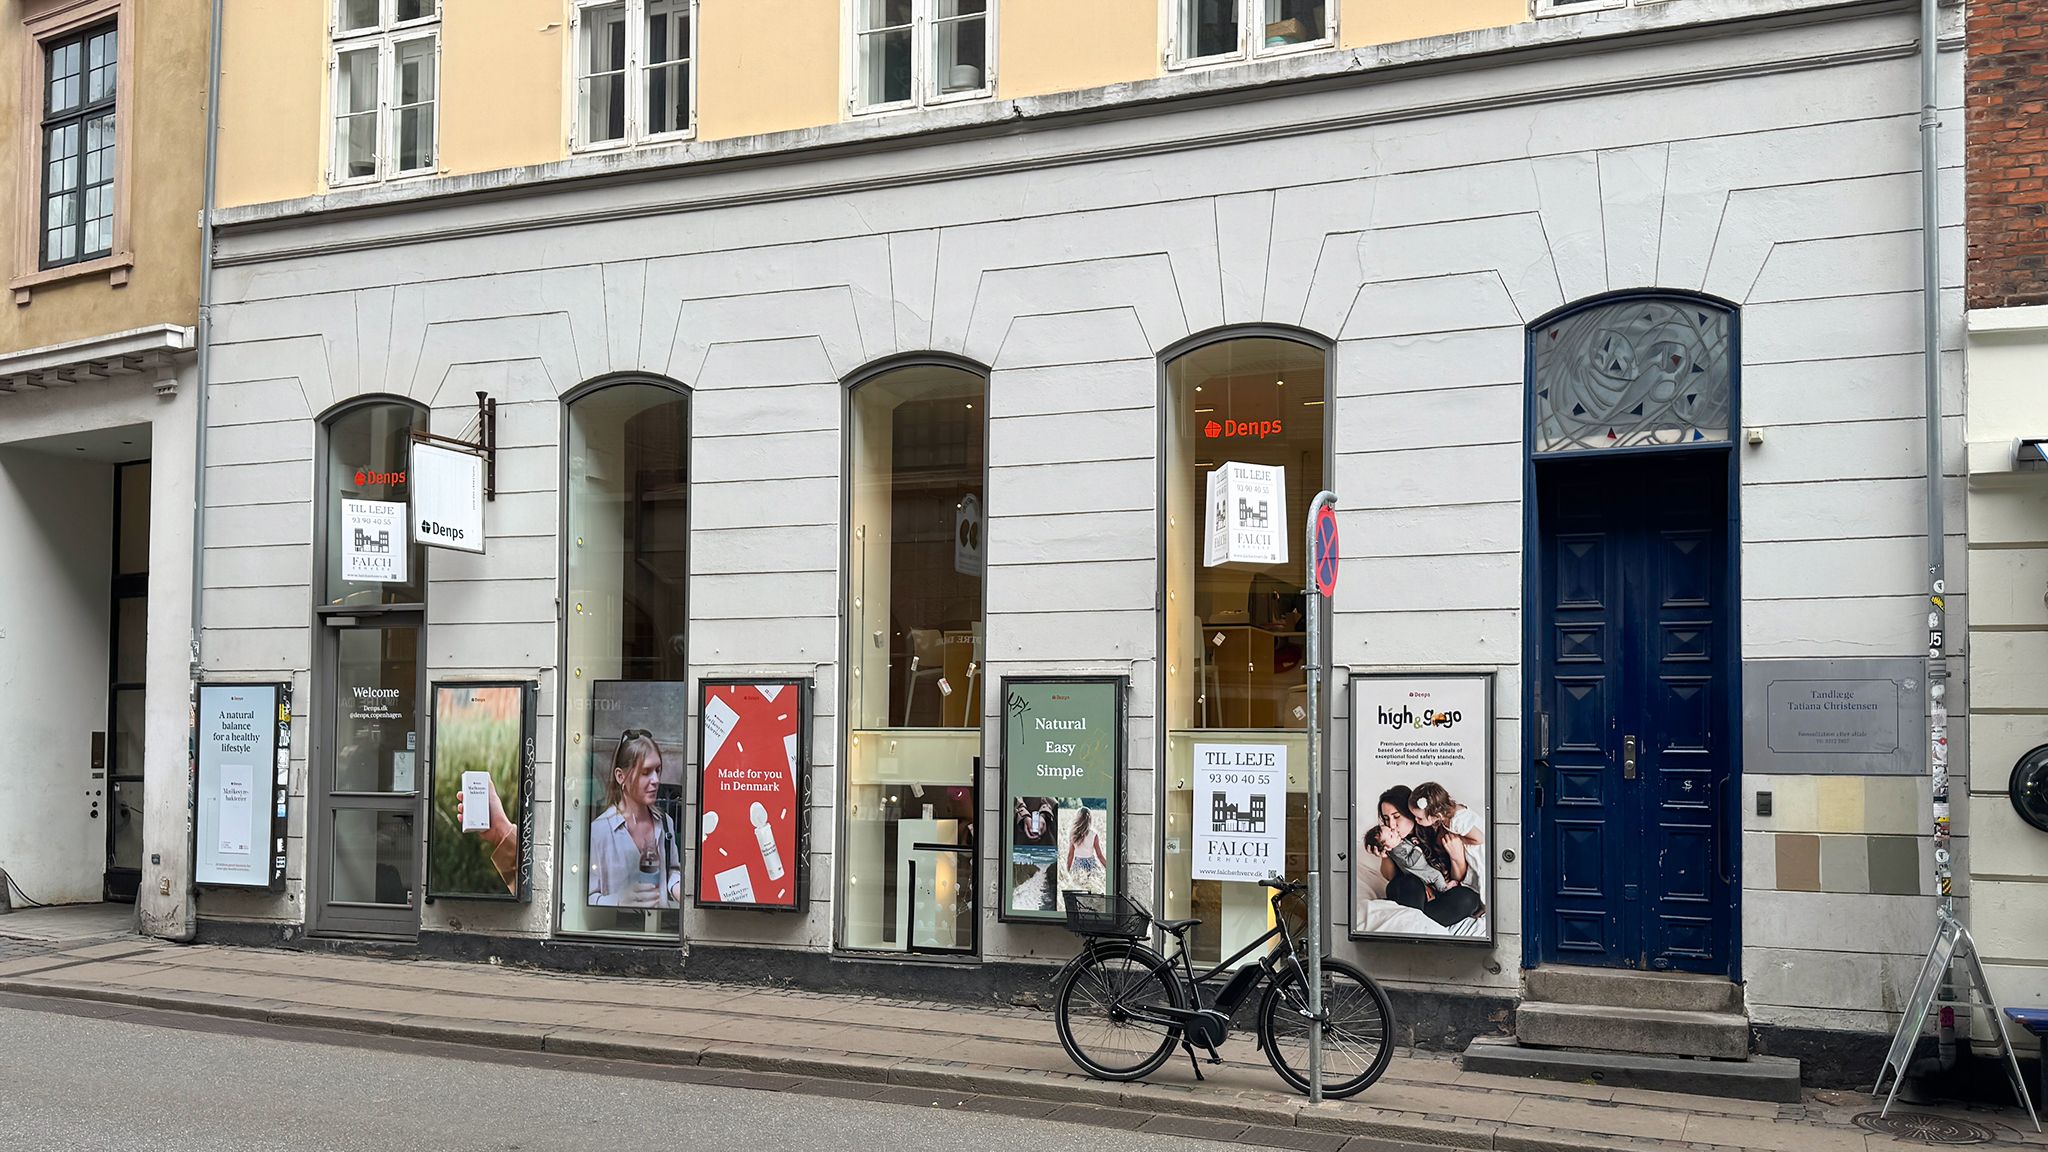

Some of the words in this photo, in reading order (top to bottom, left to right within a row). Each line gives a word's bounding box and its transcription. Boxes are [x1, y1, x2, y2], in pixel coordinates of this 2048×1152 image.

[1224, 419, 1282, 439] Denps
[368, 470, 406, 487] Denps
[1234, 468, 1249, 479] TIL
[1250, 469, 1272, 482] LEJE
[348, 503, 367, 513] TIL
[369, 504, 395, 515] LEJE
[362, 517, 371, 525] 90
[373, 517, 382, 525] 40
[432, 521, 464, 541] Denps
[1237, 532, 1271, 546] FALCH
[352, 556, 392, 568] FALCH
[352, 686, 400, 698] Welcome
[1811, 689, 1855, 700] Tandlæge
[1788, 702, 1821, 710] Tatiana
[1823, 701, 1878, 711] Christensen
[219, 711, 225, 719] A
[226, 710, 254, 719] natural
[222, 721, 251, 730] balance
[1035, 717, 1087, 730] Natural
[213, 732, 225, 741] for
[231, 732, 260, 743] healthy
[221, 743, 251, 754] lifestyle
[1045, 741, 1076, 756] Easy
[1205, 751, 1231, 765] TIL
[1235, 752, 1275, 766] LEJE
[718, 768, 744, 779] Made
[747, 768, 761, 779] for
[763, 770, 783, 781] you
[1036, 764, 1084, 780] Simple
[1209, 773, 1222, 783] 93
[1225, 773, 1238, 784] 90
[1241, 774, 1255, 784] 40
[1257, 774, 1270, 785] 55
[720, 781, 731, 790] in
[733, 781, 780, 791] Denmark
[1208, 840, 1269, 857] FALCH
[1208, 856, 1267, 864] ERHVERV
[1199, 868, 1263, 877] www.falcherhverv.dk
